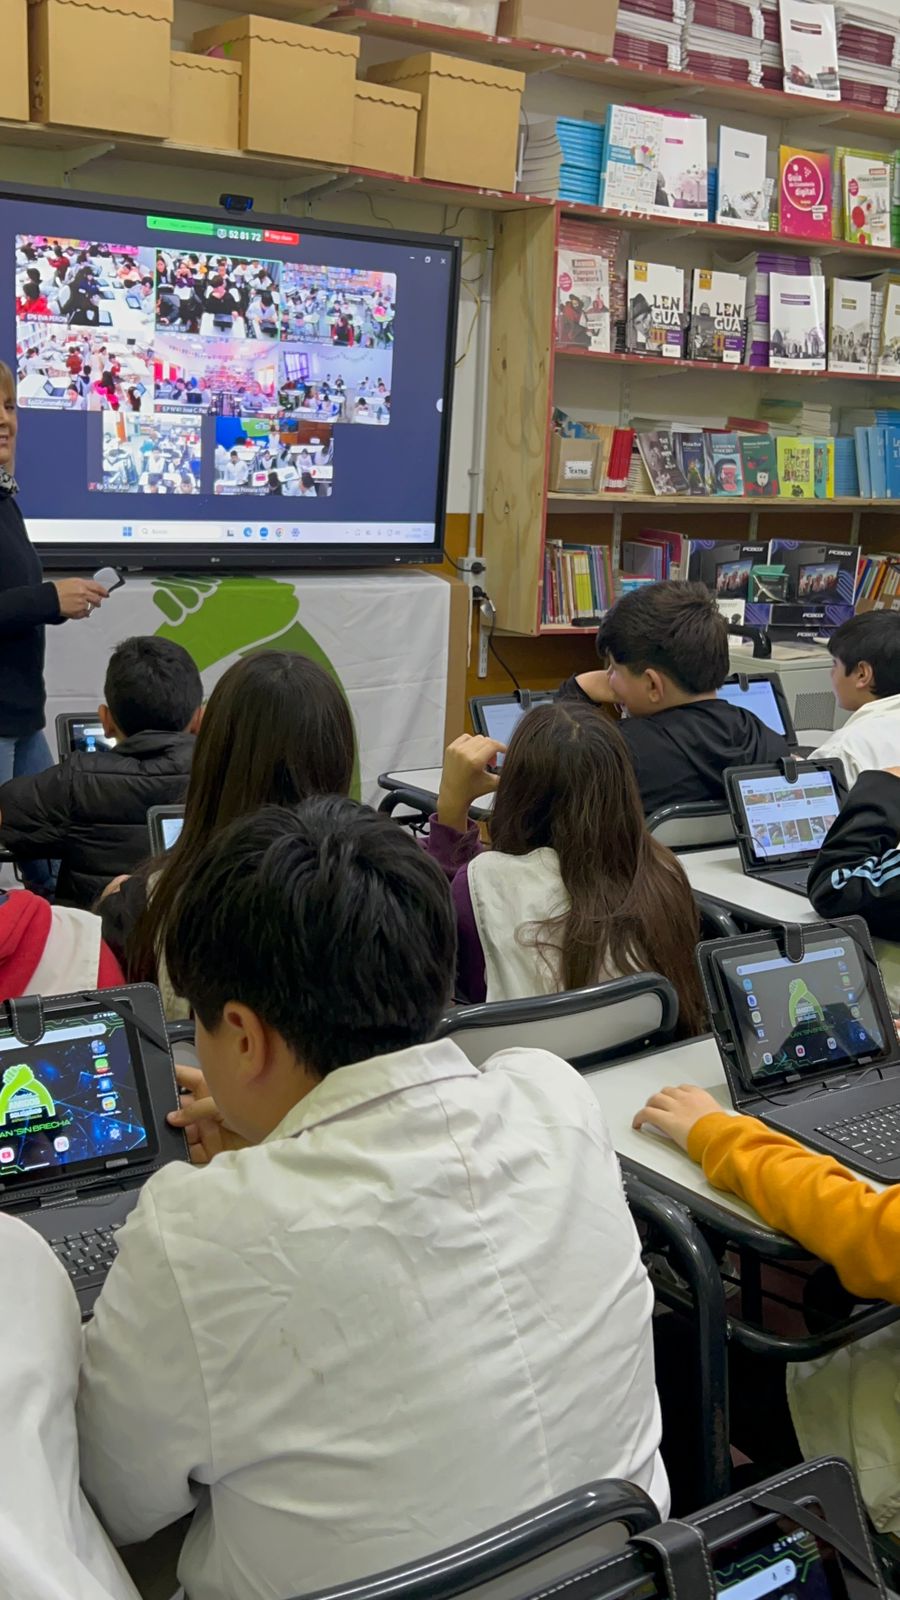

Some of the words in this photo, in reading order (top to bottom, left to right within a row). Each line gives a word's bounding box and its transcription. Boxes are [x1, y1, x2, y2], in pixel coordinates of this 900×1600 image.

[653, 294, 680, 311] LEN
[716, 302, 742, 318] LEN
[652, 311, 681, 325] GUA
[714, 317, 741, 331] GUA
[568, 466, 588, 475] TEATRO
